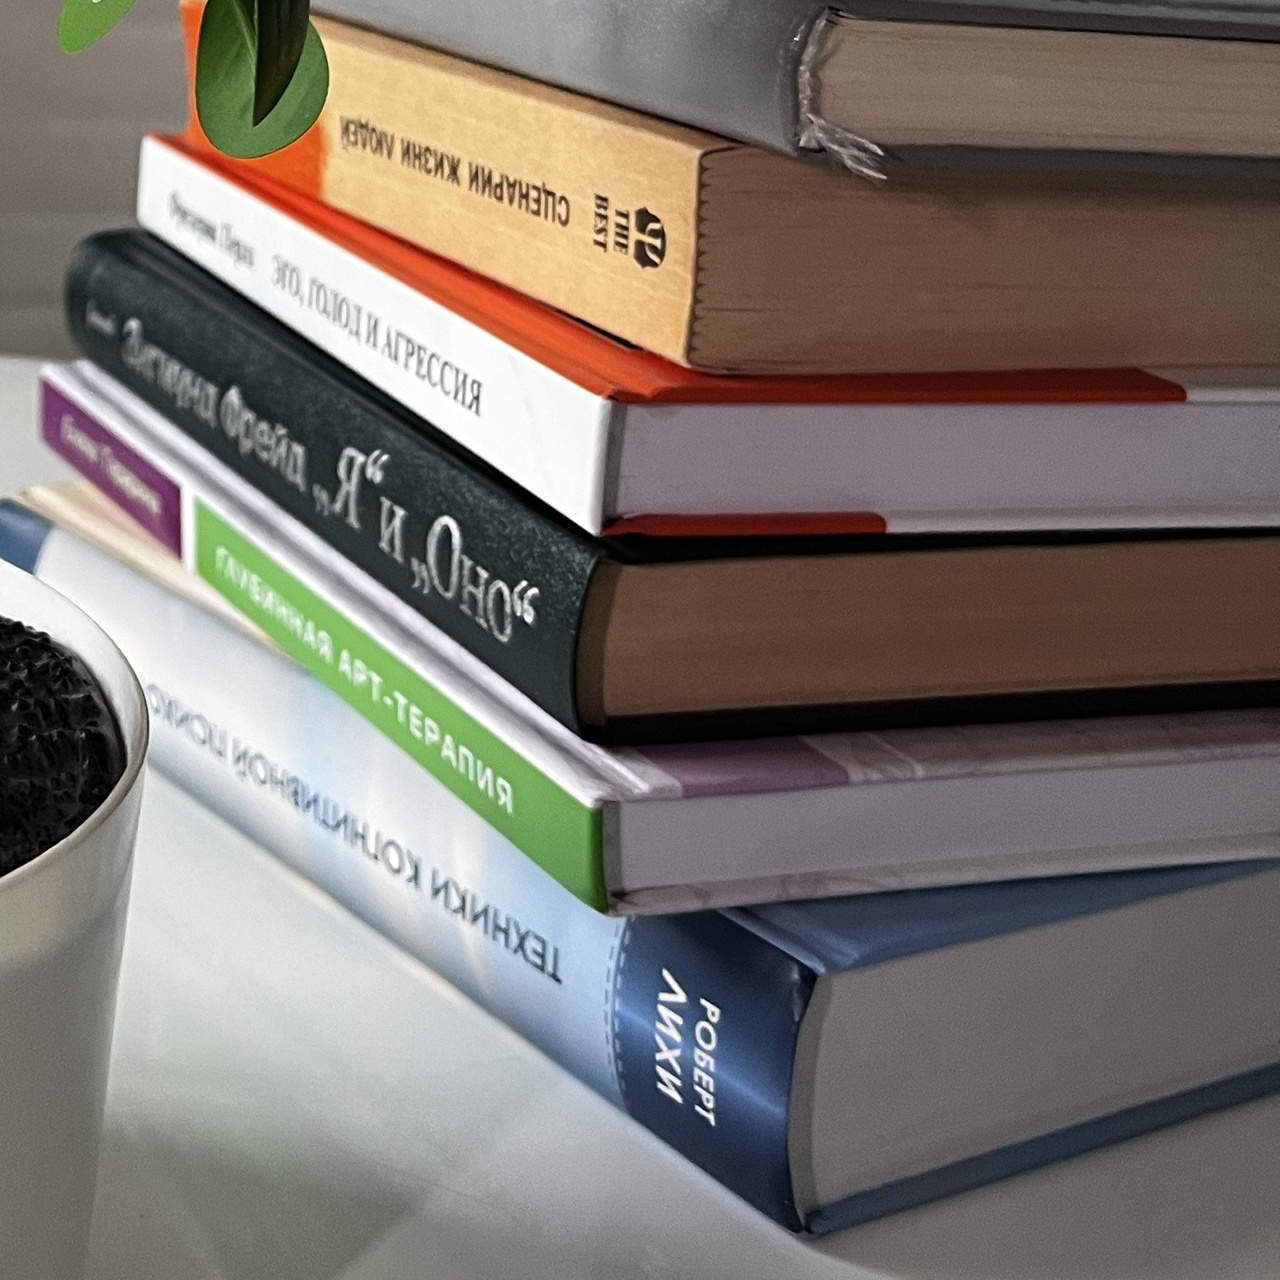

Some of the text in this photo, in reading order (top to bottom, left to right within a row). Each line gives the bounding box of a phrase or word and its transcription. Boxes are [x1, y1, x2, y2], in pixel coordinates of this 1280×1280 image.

[340, 115, 570, 228] СЦЕНАРИИ ЖИЗНИ ЛЮДЕЙ
[593, 193, 609, 253] BEST
[613, 209, 630, 255] THE
[307, 274, 363, 342] ГОЛОД
[366, 310, 382, 351] И
[383, 325, 483, 416] АГРЕССИЯ
[220, 384, 307, 493] Фрейд
[338, 648, 514, 815] АРТ-ТЕРАПИЯ
[232, 735, 422, 890] КОГНИТИВНОЙ
[430, 867, 563, 984] ТЕХНИКИ
[654, 968, 687, 1104] ЛИХИ
[694, 997, 721, 1127] РОБЕРТ
